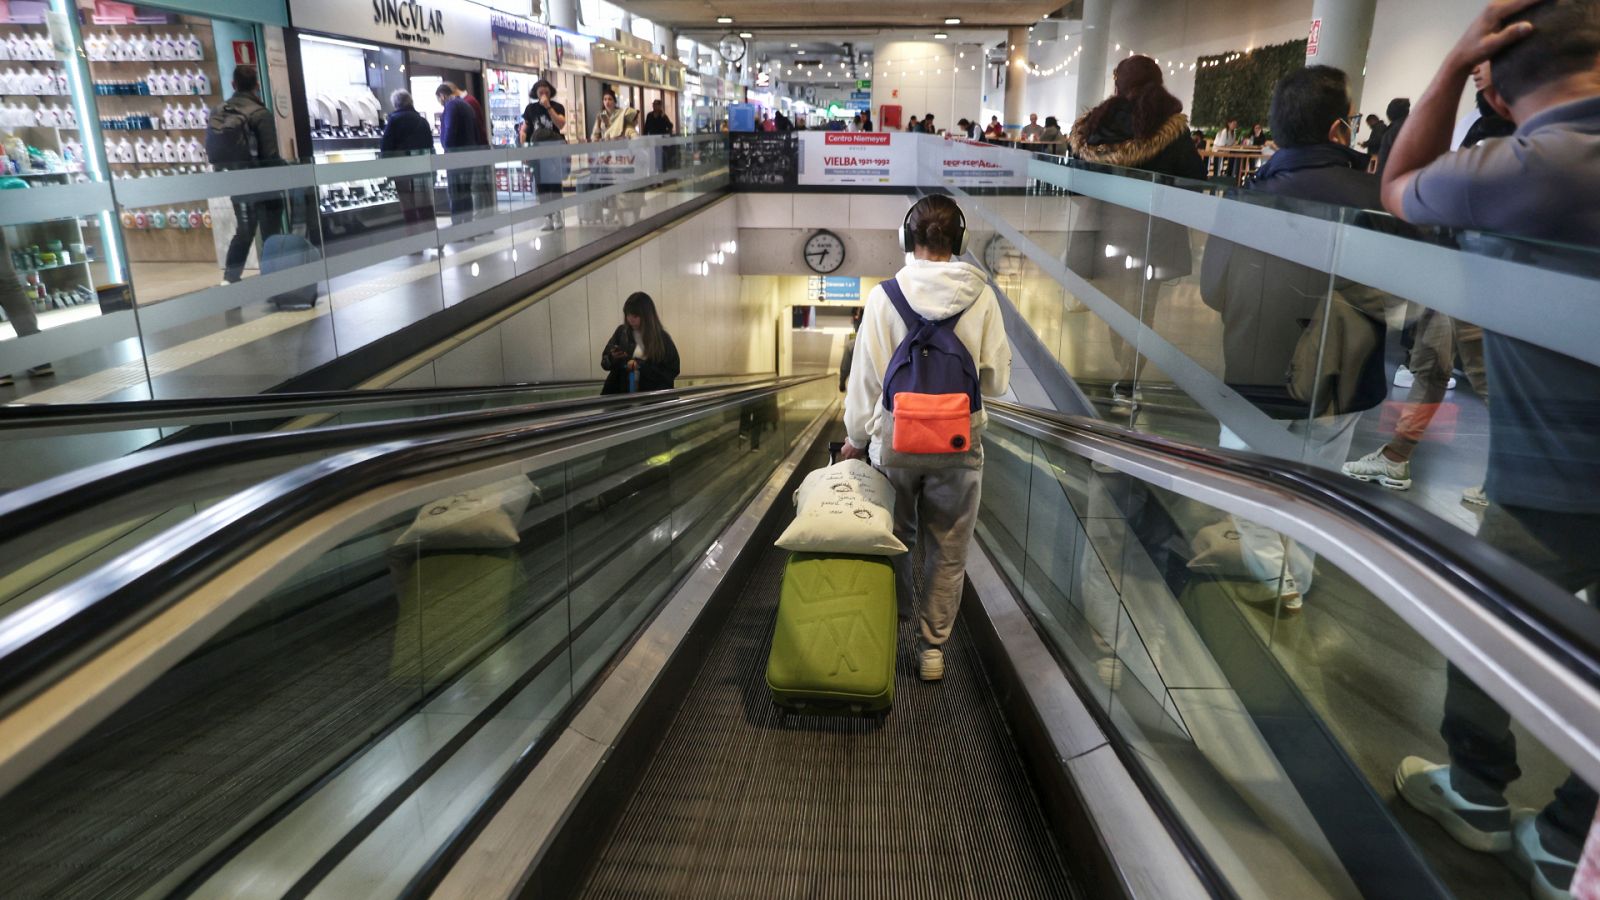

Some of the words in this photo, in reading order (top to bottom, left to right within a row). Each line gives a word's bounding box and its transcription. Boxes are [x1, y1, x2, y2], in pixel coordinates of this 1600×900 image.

[828, 135, 852, 143] Centro
[853, 135, 887, 143] Niemeyer
[824, 157, 857, 166] VIELBA
